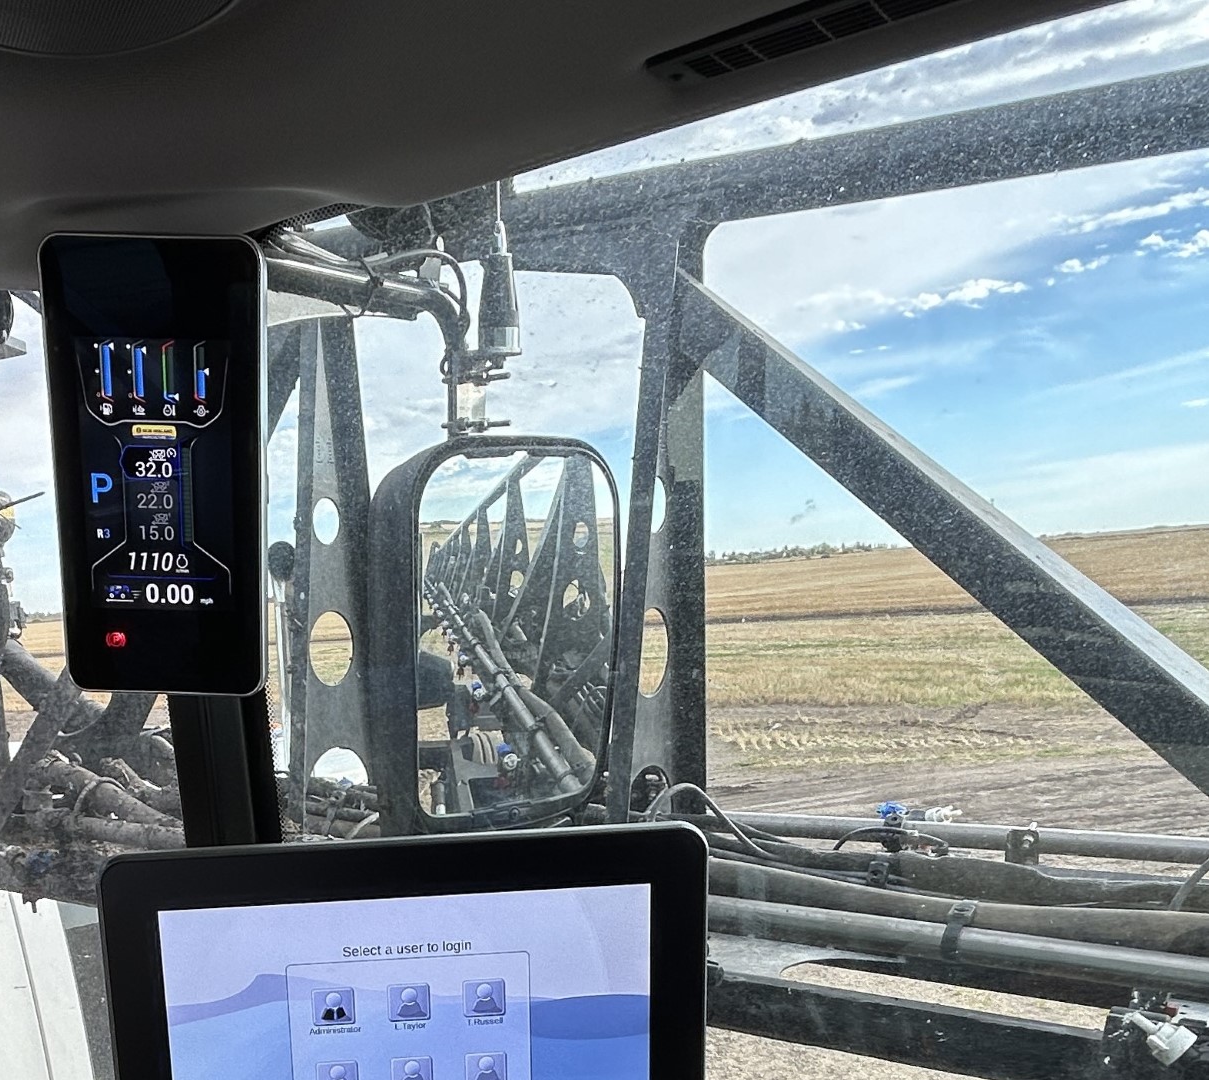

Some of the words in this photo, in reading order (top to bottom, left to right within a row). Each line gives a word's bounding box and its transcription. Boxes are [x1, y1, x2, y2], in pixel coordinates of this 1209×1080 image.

[135, 462, 173, 478] 32.0
[90, 473, 113, 503] P
[137, 494, 174, 509] 22.0
[96, 528, 111, 539] R3
[139, 526, 175, 540] 15.0
[128, 552, 174, 571] 1110
[146, 584, 194, 604] 0.00
[342, 946, 382, 958] Select
[385, 947, 392, 955] a
[396, 944, 423, 954] user
[427, 942, 438, 952] to
[442, 940, 472, 954] login
[310, 1026, 361, 1035] Administrator
